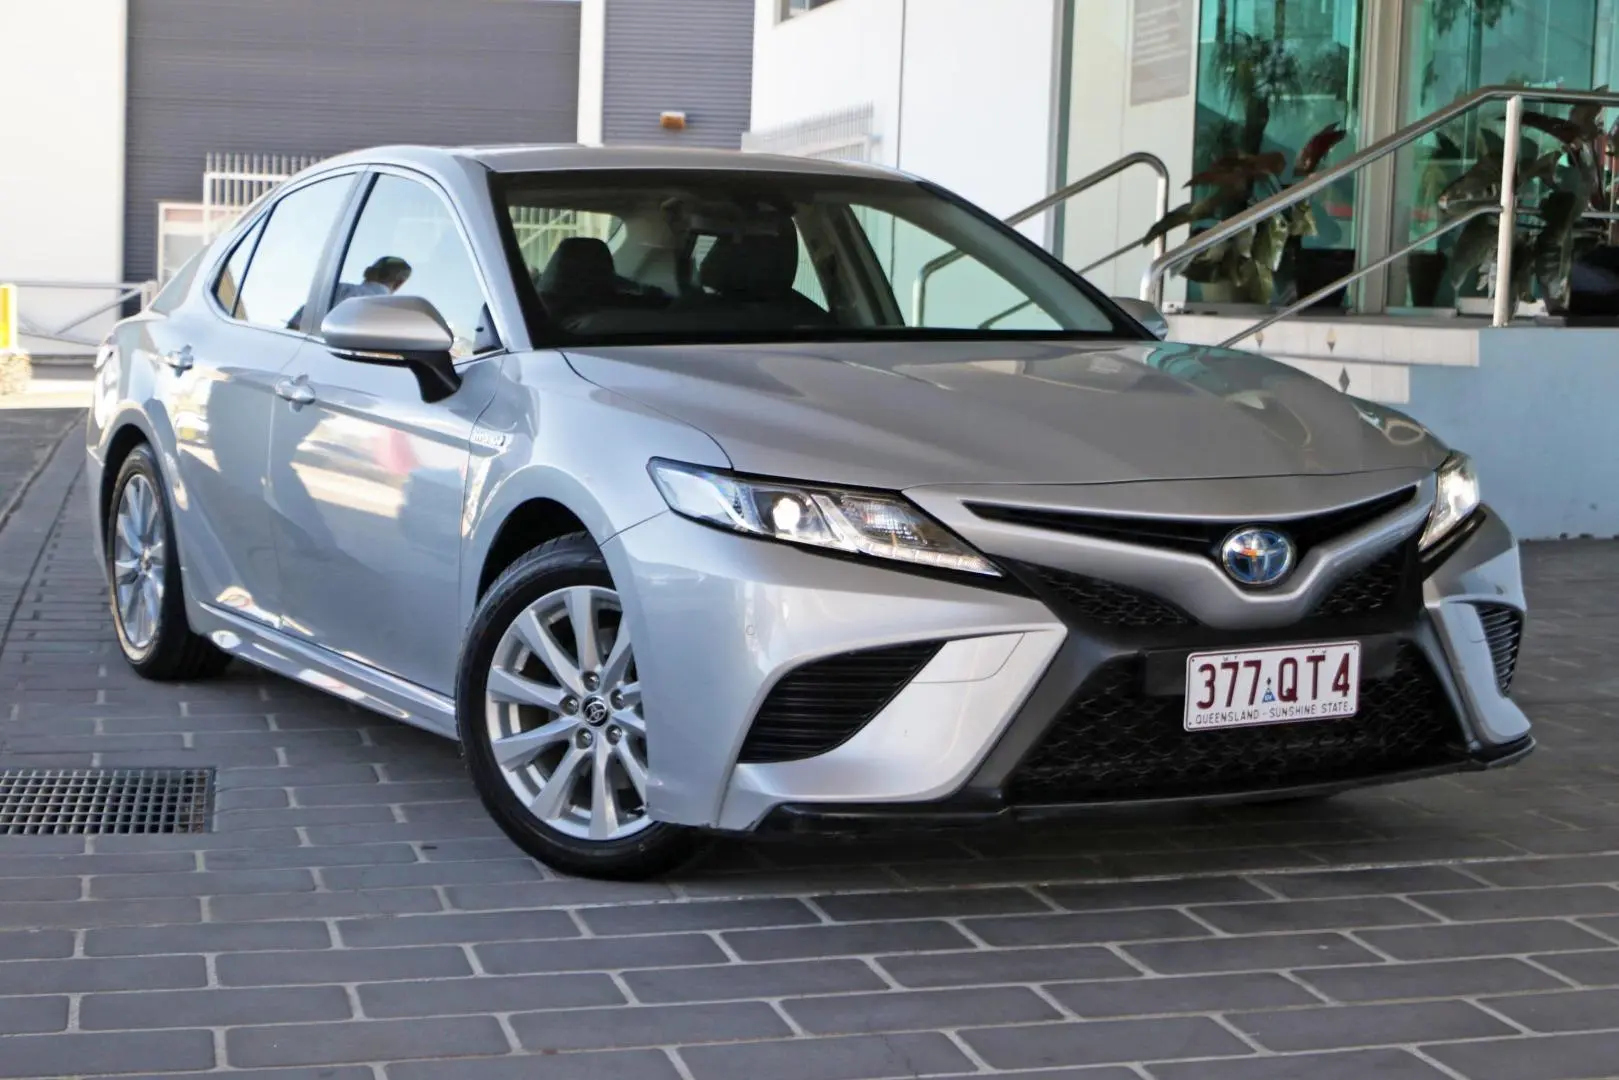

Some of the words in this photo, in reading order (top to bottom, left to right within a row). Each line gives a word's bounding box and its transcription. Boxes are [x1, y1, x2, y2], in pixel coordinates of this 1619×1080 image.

[1197, 660, 1261, 709] 377
[1277, 653, 1350, 703] QT4
[1195, 709, 1259, 724] QUEENSLAND
[1269, 705, 1317, 718] SUNSHINE
[1321, 701, 1349, 713] STATE
